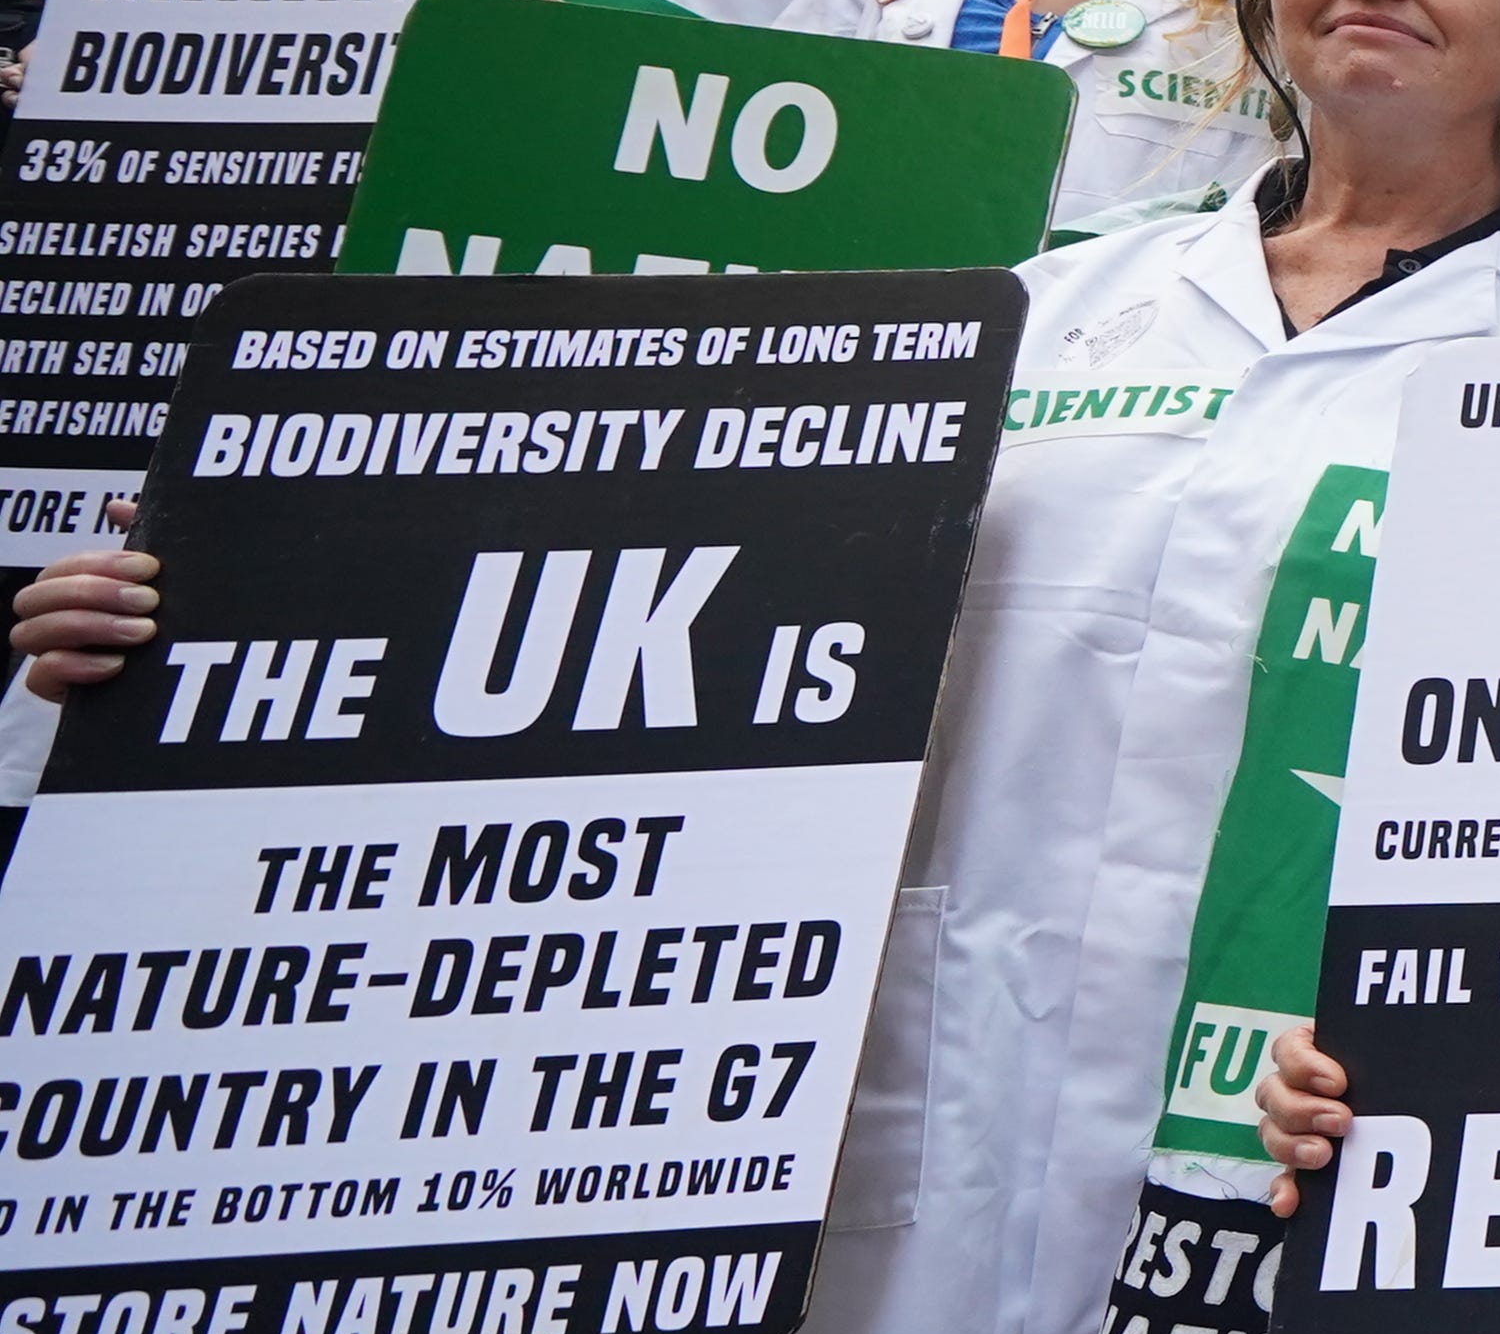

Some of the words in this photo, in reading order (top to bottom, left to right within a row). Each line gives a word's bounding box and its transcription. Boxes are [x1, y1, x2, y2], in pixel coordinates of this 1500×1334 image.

[18, 141, 107, 184] 33%
[117, 150, 157, 183] OF
[166, 152, 321, 185] SENSITIVE
[614, 66, 838, 194] NO
[232, 329, 374, 371] BASED
[385, 331, 448, 370] ON
[456, 328, 683, 370] ESTIMATES
[696, 327, 748, 364] OF
[756, 326, 855, 364] LONG
[871, 322, 981, 361] TERM
[193, 410, 687, 477] BIODIVERSITY
[696, 401, 966, 468] DECLINE
[159, 637, 388, 744] THE
[432, 545, 741, 737] UK
[752, 622, 866, 726] IS
[255, 844, 397, 914] THE
[418, 816, 685, 908] MOST
[2, 919, 842, 1036] NATURE-DEPLETED
[1354, 948, 1472, 1005] FAIL
[602, 1252, 782, 1333] NOW
